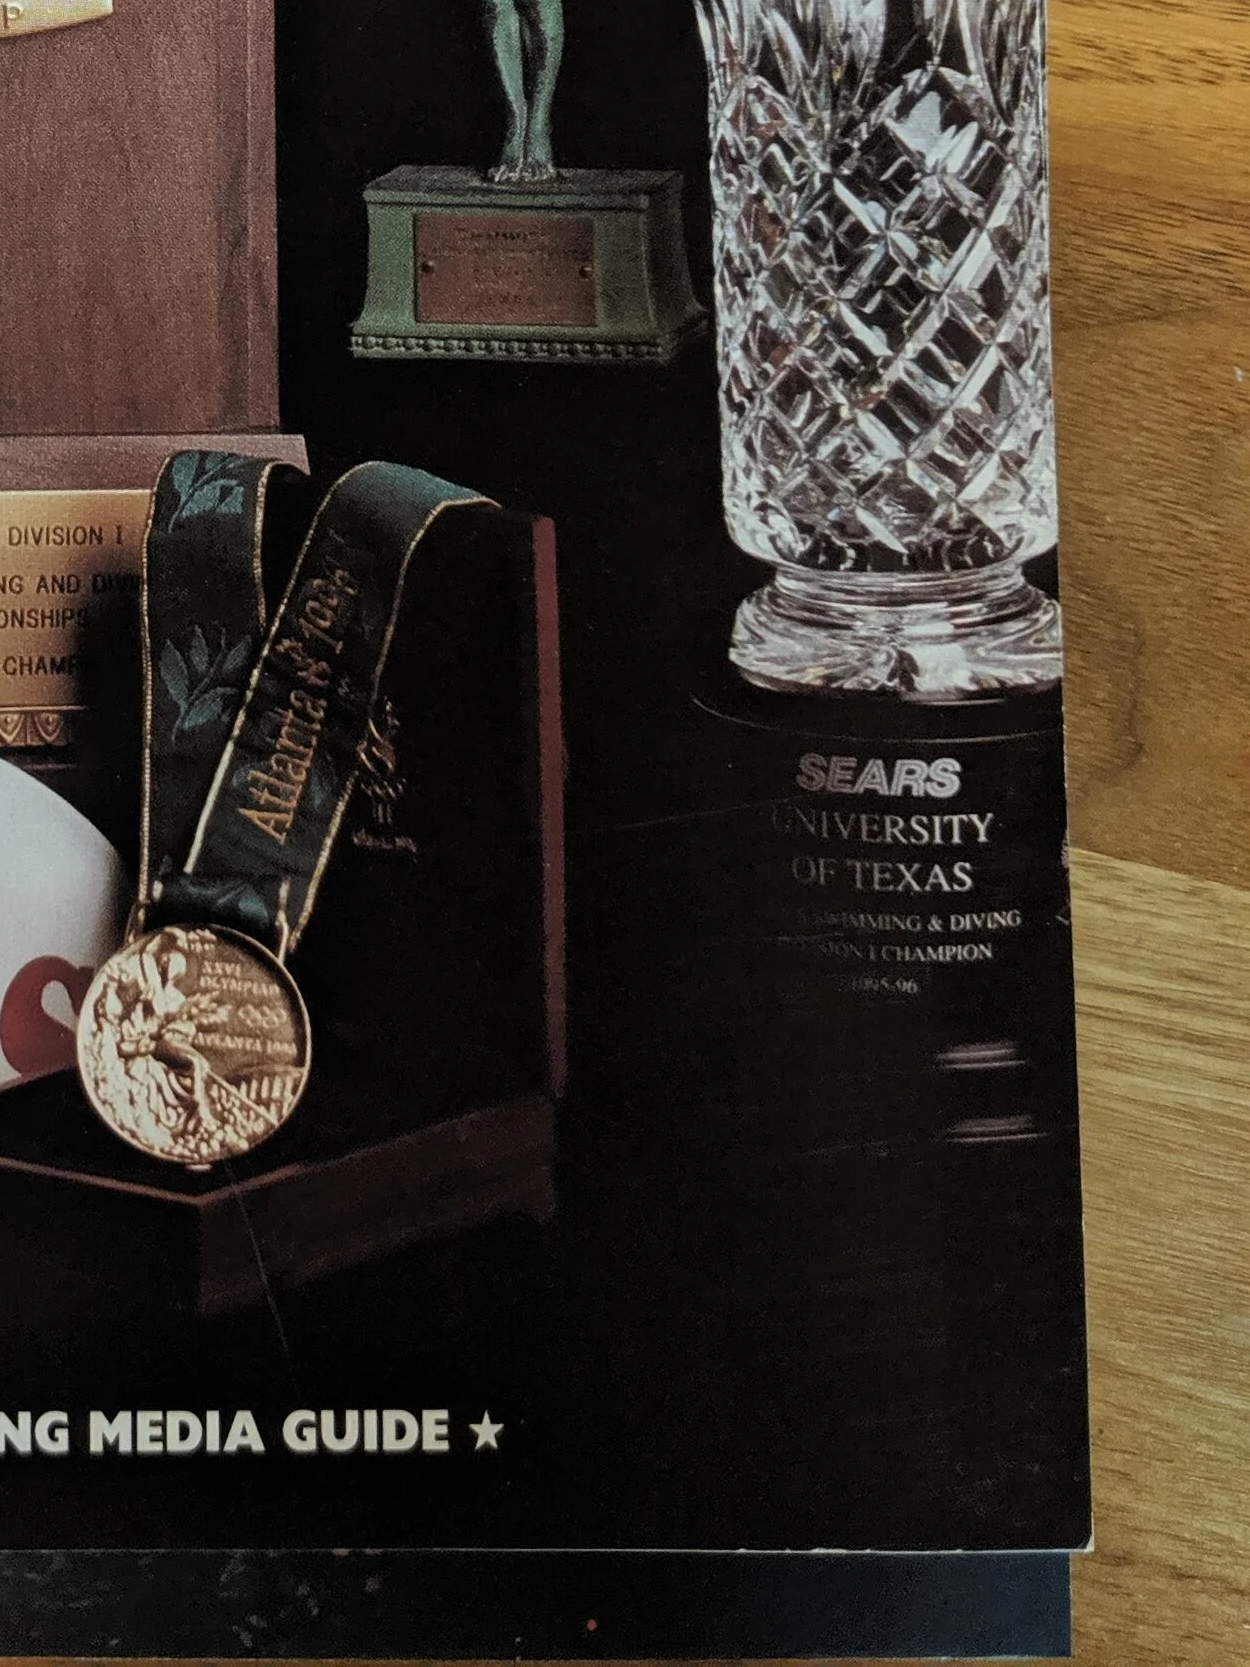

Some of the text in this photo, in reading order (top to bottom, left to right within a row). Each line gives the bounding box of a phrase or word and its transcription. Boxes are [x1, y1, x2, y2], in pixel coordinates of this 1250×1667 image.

[8, 524, 104, 547] DIVISION
[114, 524, 124, 546] I
[35, 572, 82, 594] AND
[238, 688, 327, 846] Atlanta
[796, 752, 962, 799] SEARS
[791, 855, 974, 893] OF TEXAS
[927, 914, 944, 932] &
[950, 909, 1023, 931] DIVING
[880, 941, 994, 963] CHAMPION
[88, 1409, 266, 1456] MEDIA
[281, 1408, 451, 1455] GUIDE
